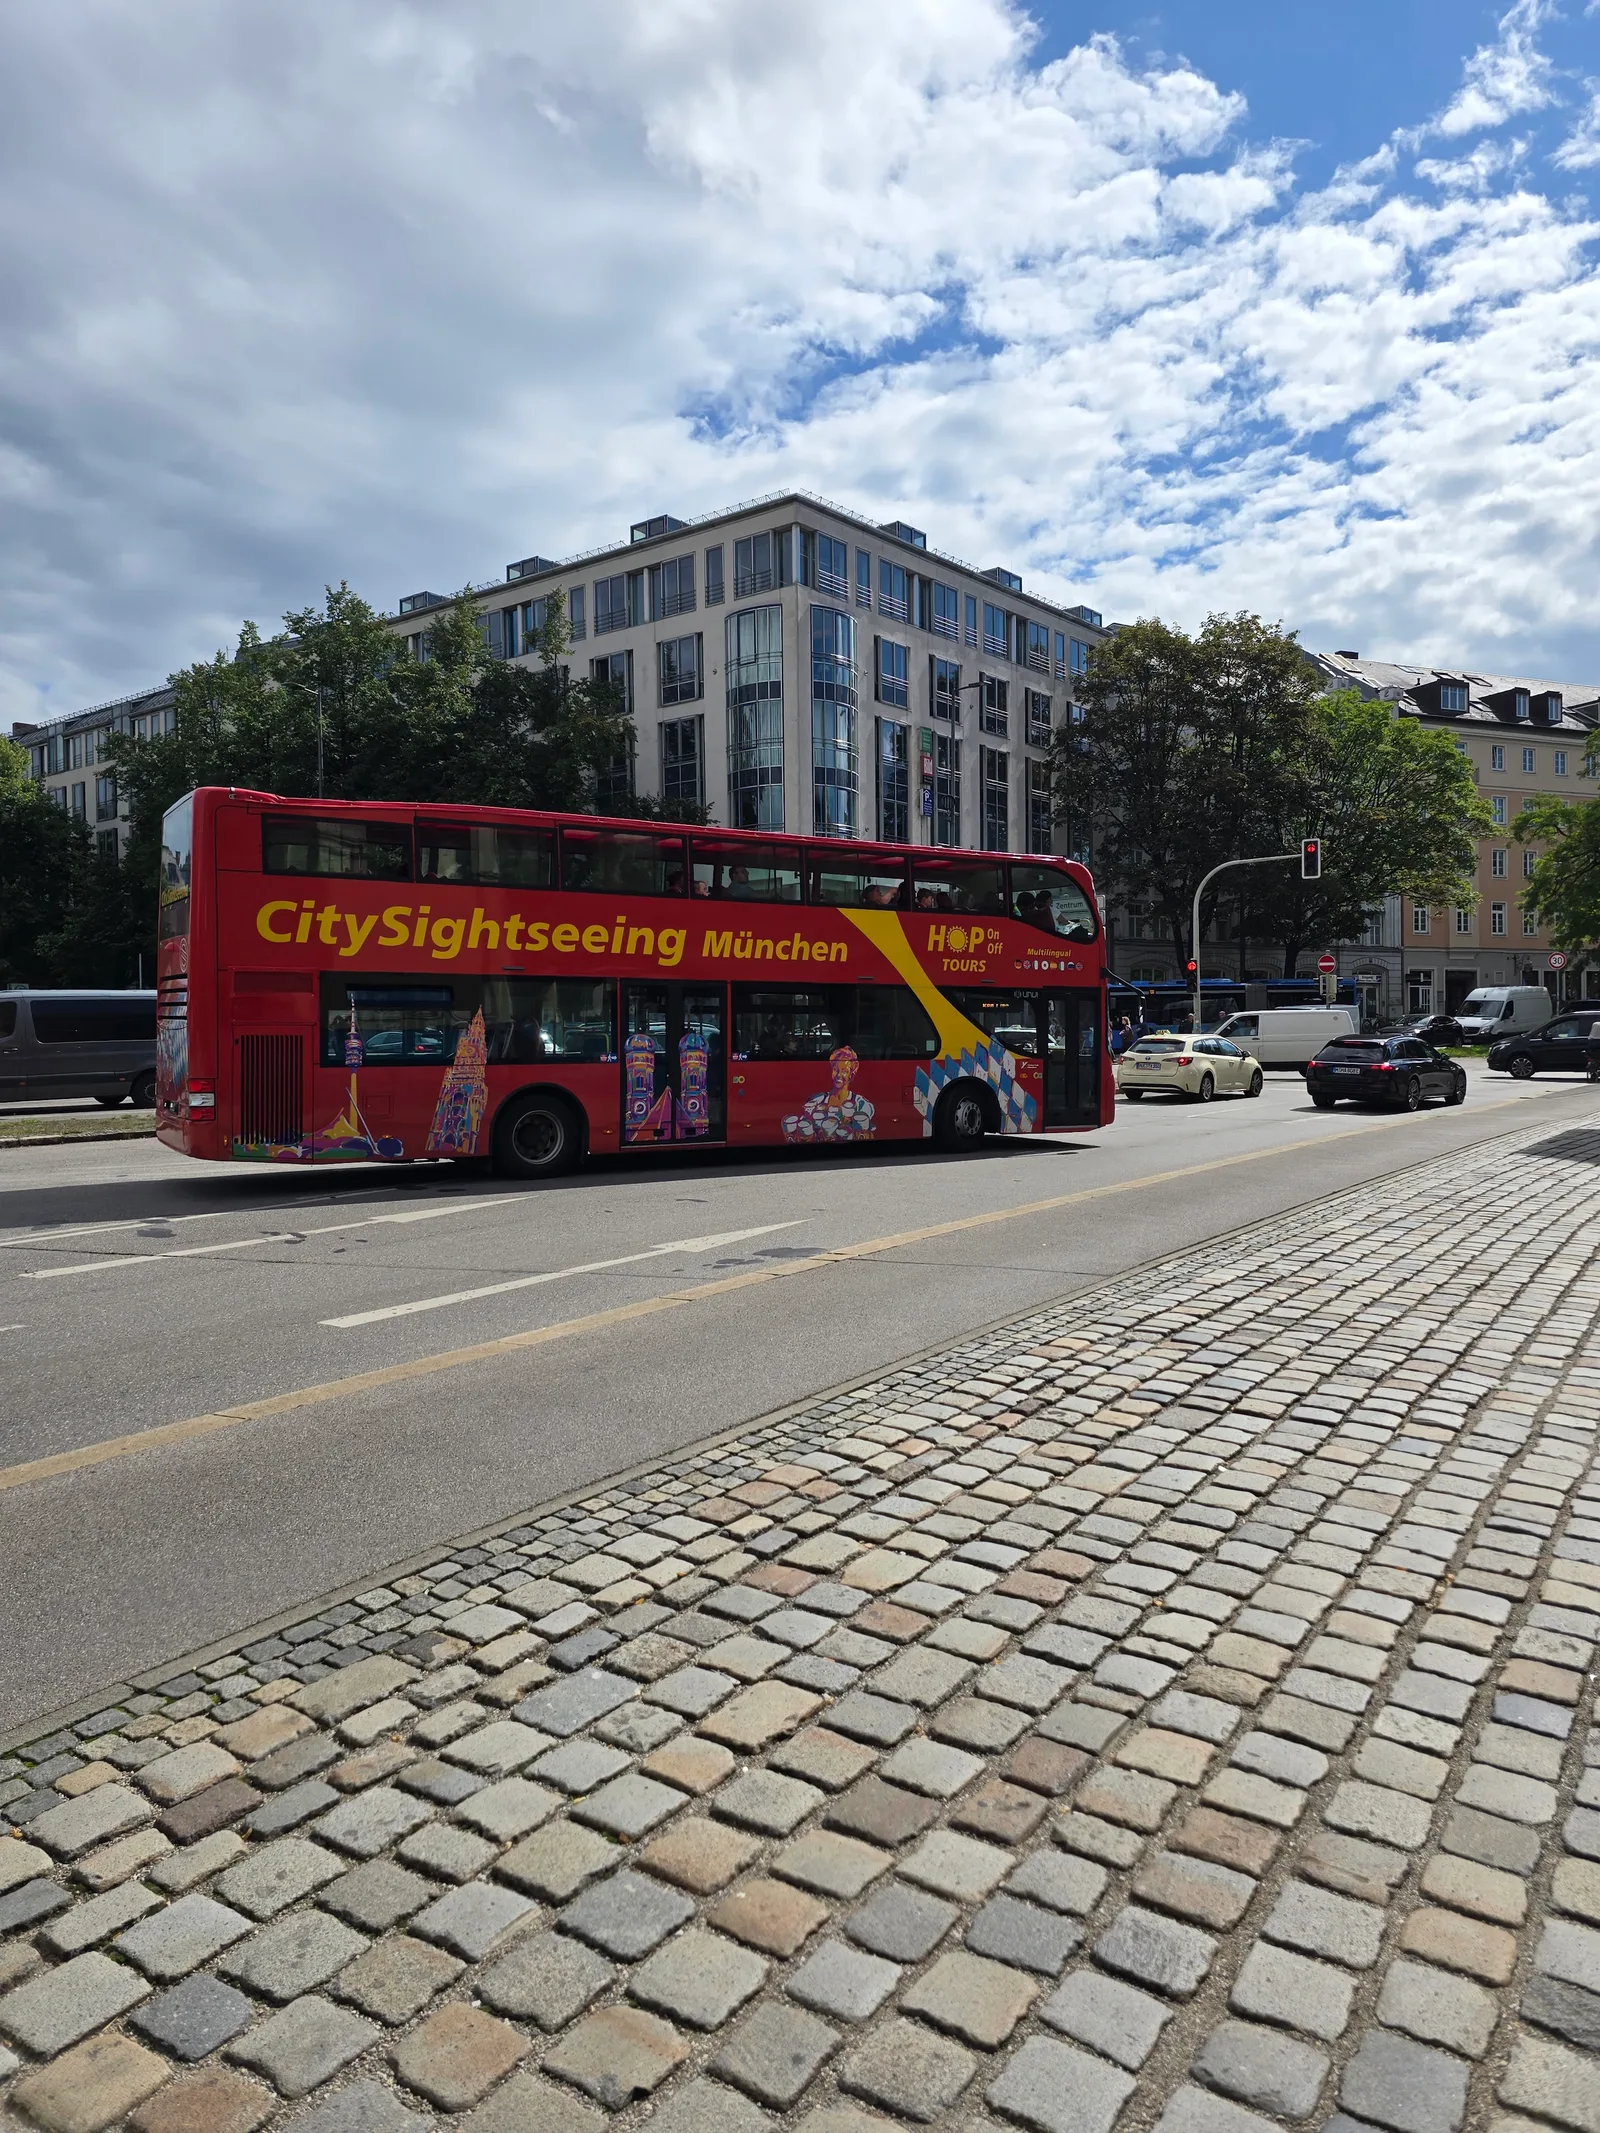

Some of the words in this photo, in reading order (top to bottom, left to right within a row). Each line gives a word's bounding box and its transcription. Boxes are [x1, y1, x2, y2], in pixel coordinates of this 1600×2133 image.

[1056, 902, 1084, 910] Zentrum
[256, 899, 687, 967] CitySightseeing
[702, 930, 848, 962] München
[987, 928, 1000, 940] On
[987, 943, 1003, 955] Off
[1027, 948, 1072, 958] Multilingual
[942, 958, 987, 973] TOURS
[1552, 957, 1563, 965] 30
